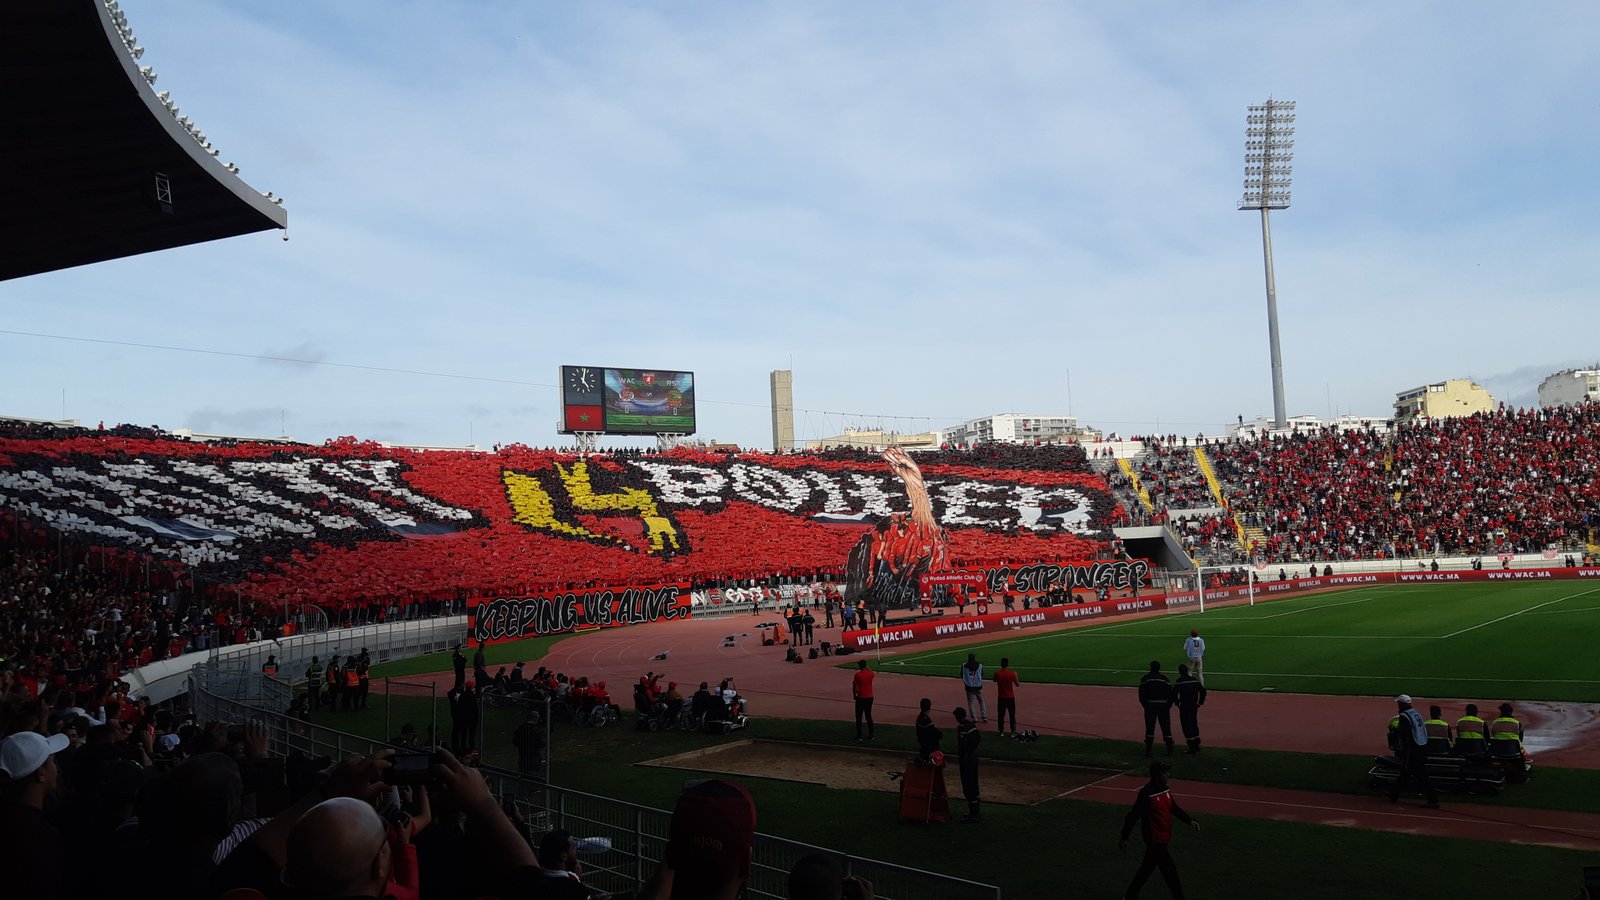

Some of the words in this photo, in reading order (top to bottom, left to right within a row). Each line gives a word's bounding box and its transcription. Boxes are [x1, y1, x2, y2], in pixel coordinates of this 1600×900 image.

[1014, 560, 1148, 593] STRONGER
[1330, 575, 1377, 584] WWW.WAC.MA
[1401, 572, 1460, 581] WWW.WAC.MA
[1487, 570, 1552, 579] WWW.WAC.MA
[1063, 605, 1102, 618] WWW.WAC.MA
[1117, 599, 1152, 611] WWW.WAC.MA
[475, 593, 579, 641] KEEPING
[584, 590, 612, 625] US
[616, 586, 688, 624] ALIVE.
[1002, 612, 1046, 626] WWW.WAC.MA
[935, 620, 985, 635] WWW.WAC.MA
[857, 629, 914, 646] WWW.WAC.MA
